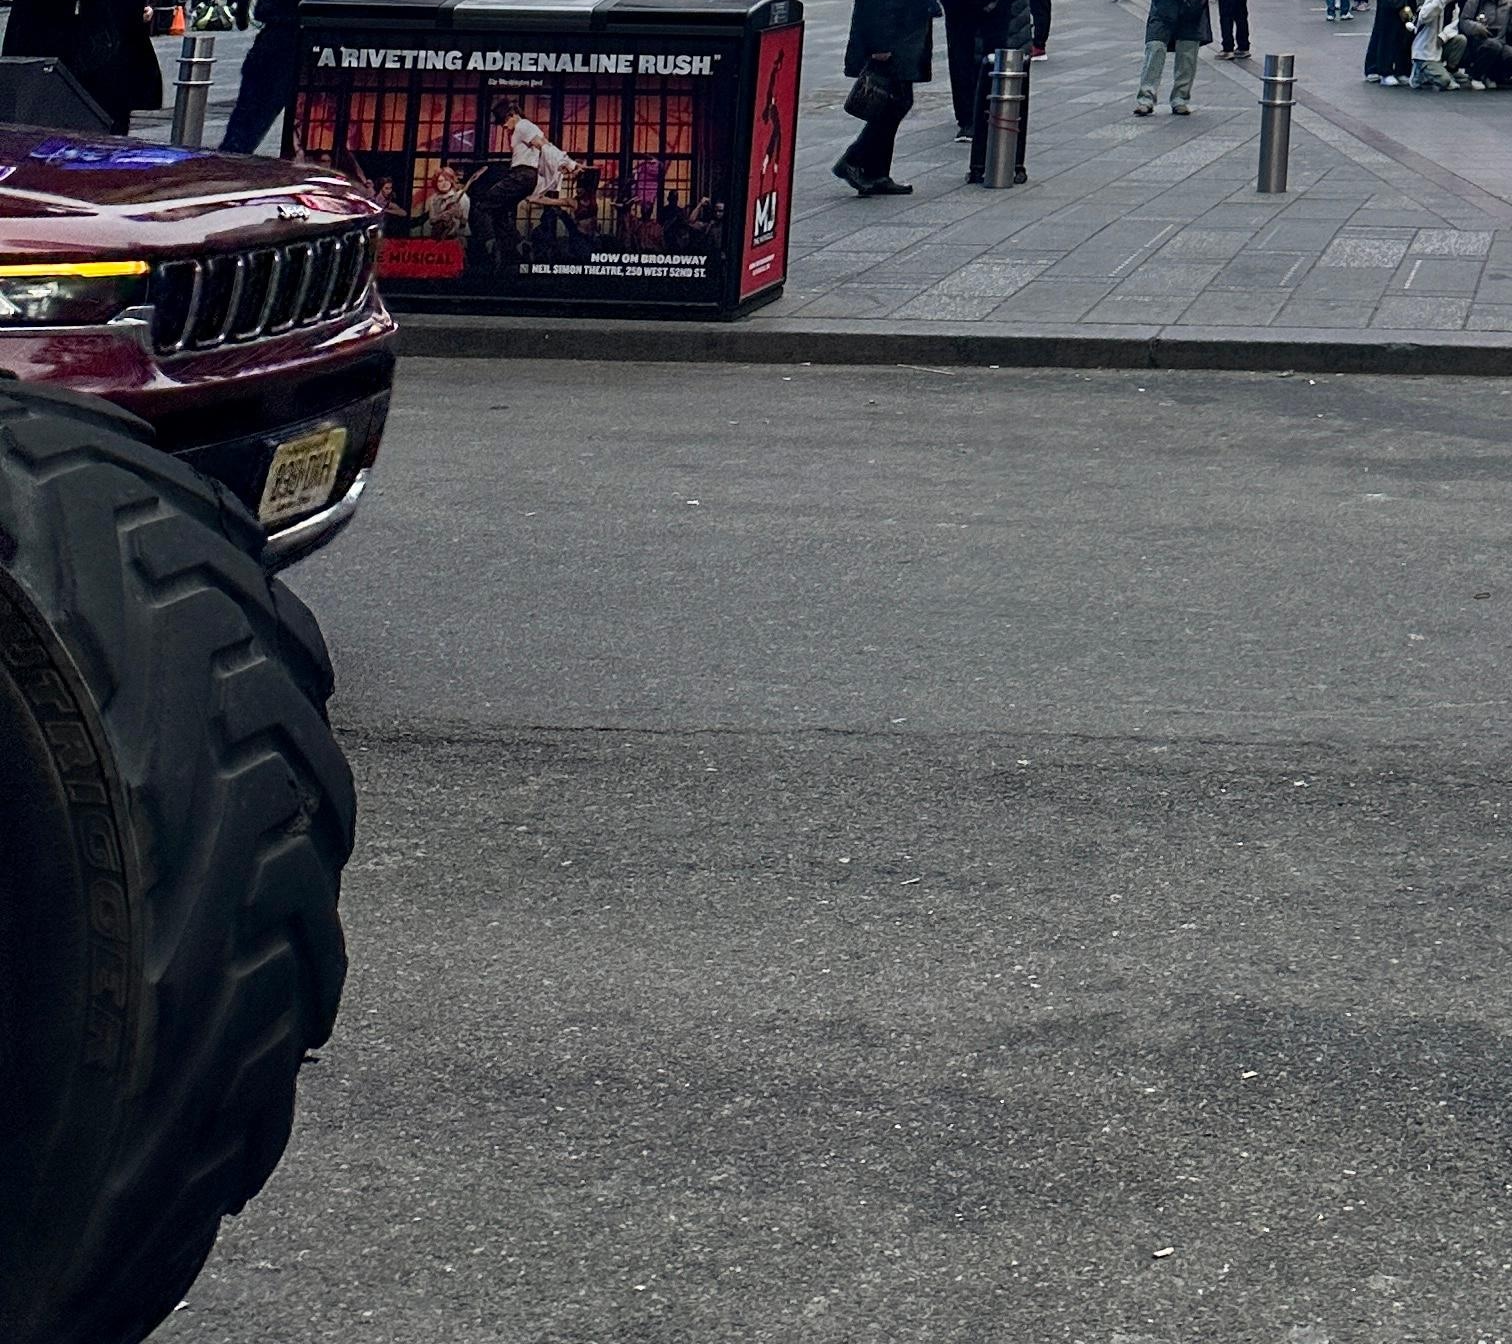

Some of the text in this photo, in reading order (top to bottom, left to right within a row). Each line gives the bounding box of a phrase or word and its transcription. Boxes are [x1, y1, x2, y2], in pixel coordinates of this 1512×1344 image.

[341, 46, 463, 70] RIVETING
[466, 50, 634, 74] ADRENALINE
[753, 190, 778, 237] MJ
[388, 251, 453, 266] MUSICAL
[590, 252, 708, 266] NOW ON BROADWAY
[584, 264, 625, 277] THEATRE,
[643, 266, 669, 277] WEST
